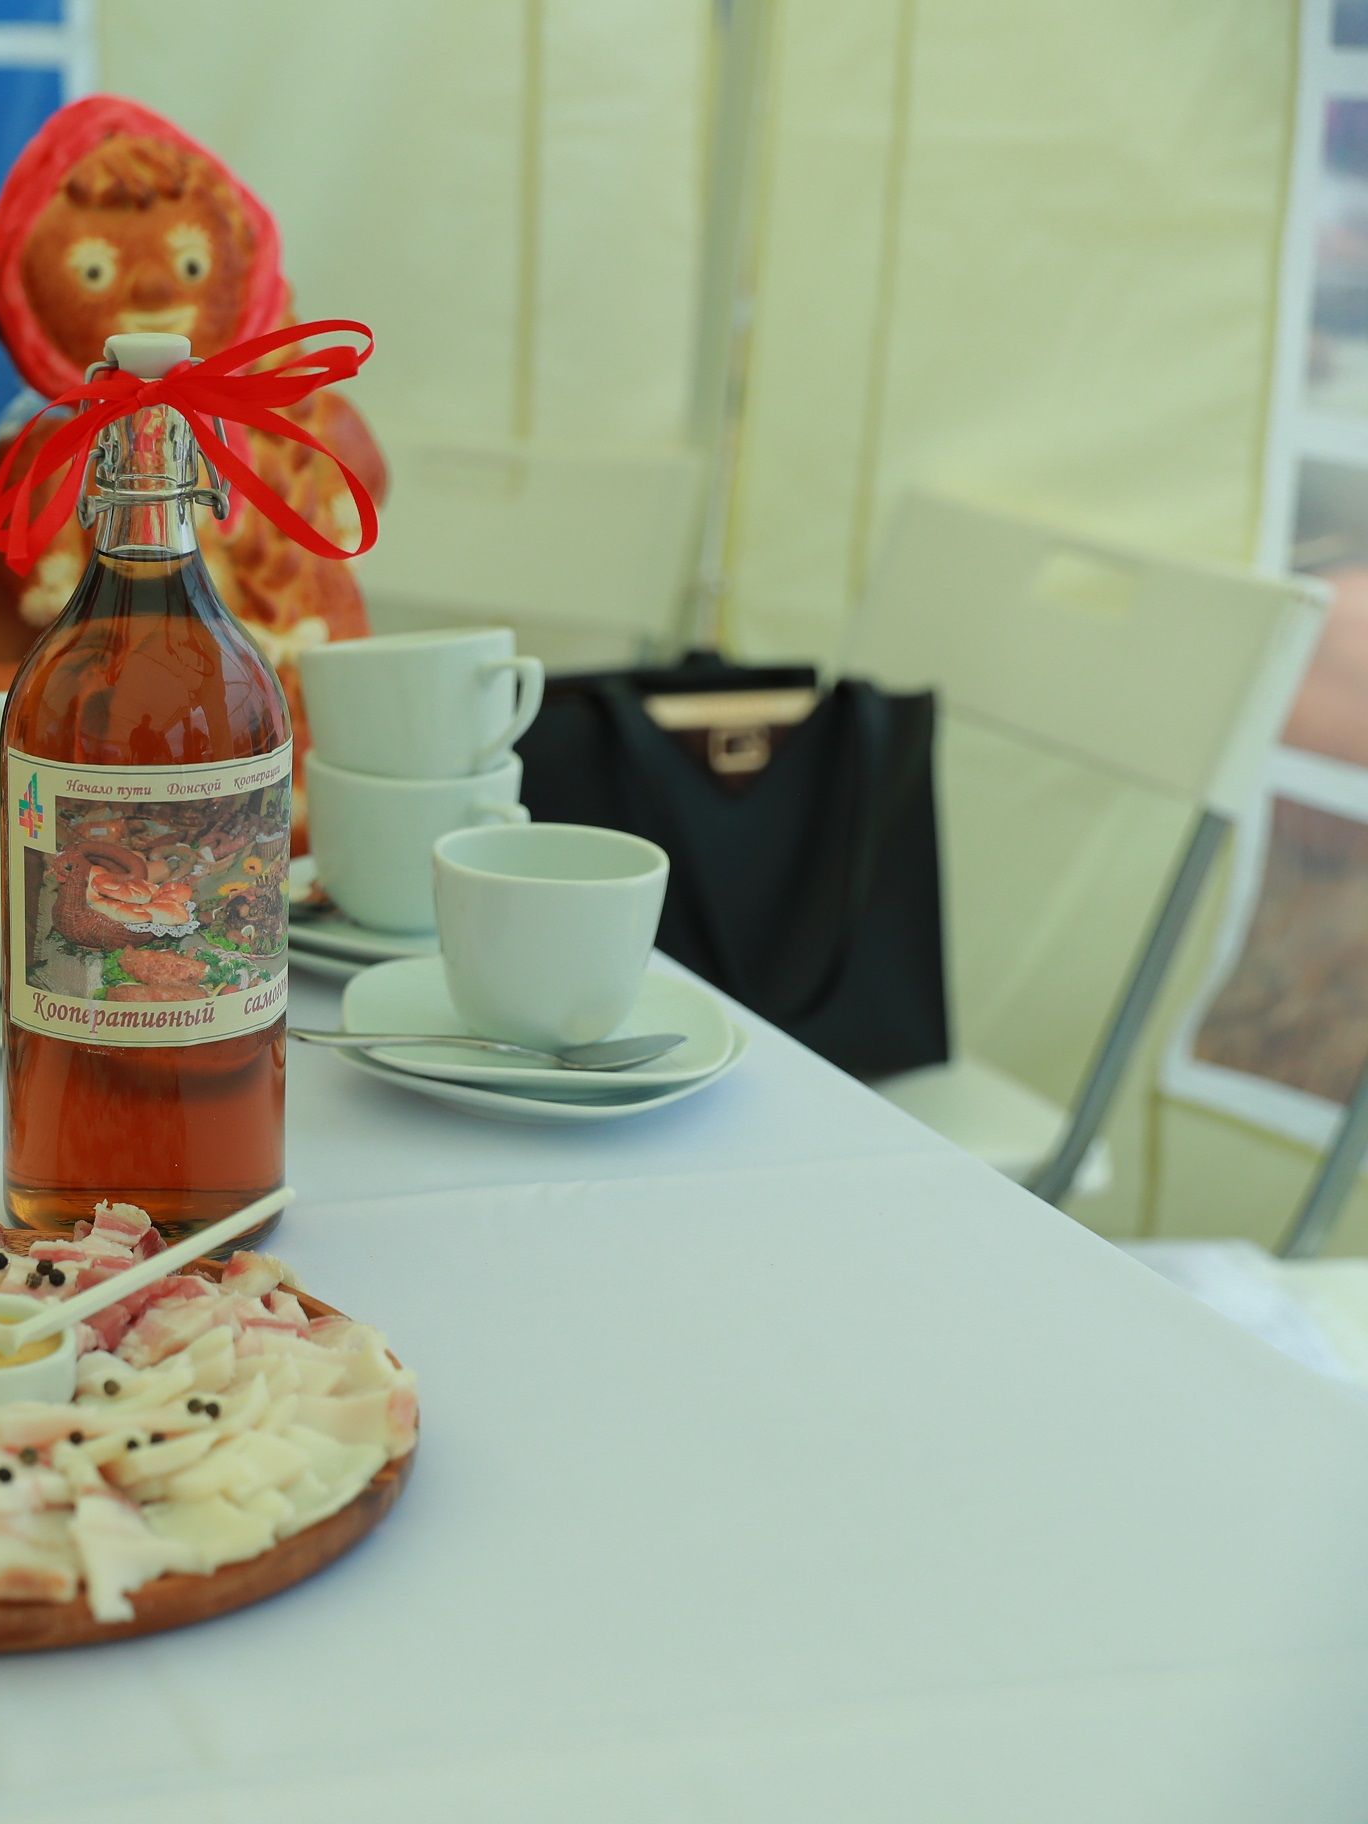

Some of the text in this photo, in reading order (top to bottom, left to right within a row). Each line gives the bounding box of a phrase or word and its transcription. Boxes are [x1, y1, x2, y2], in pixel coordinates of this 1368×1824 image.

[66, 779, 112, 795] Начало
[117, 786, 152, 800] пути
[166, 778, 222, 796] Донской
[33, 991, 216, 1034] Кооперативный
